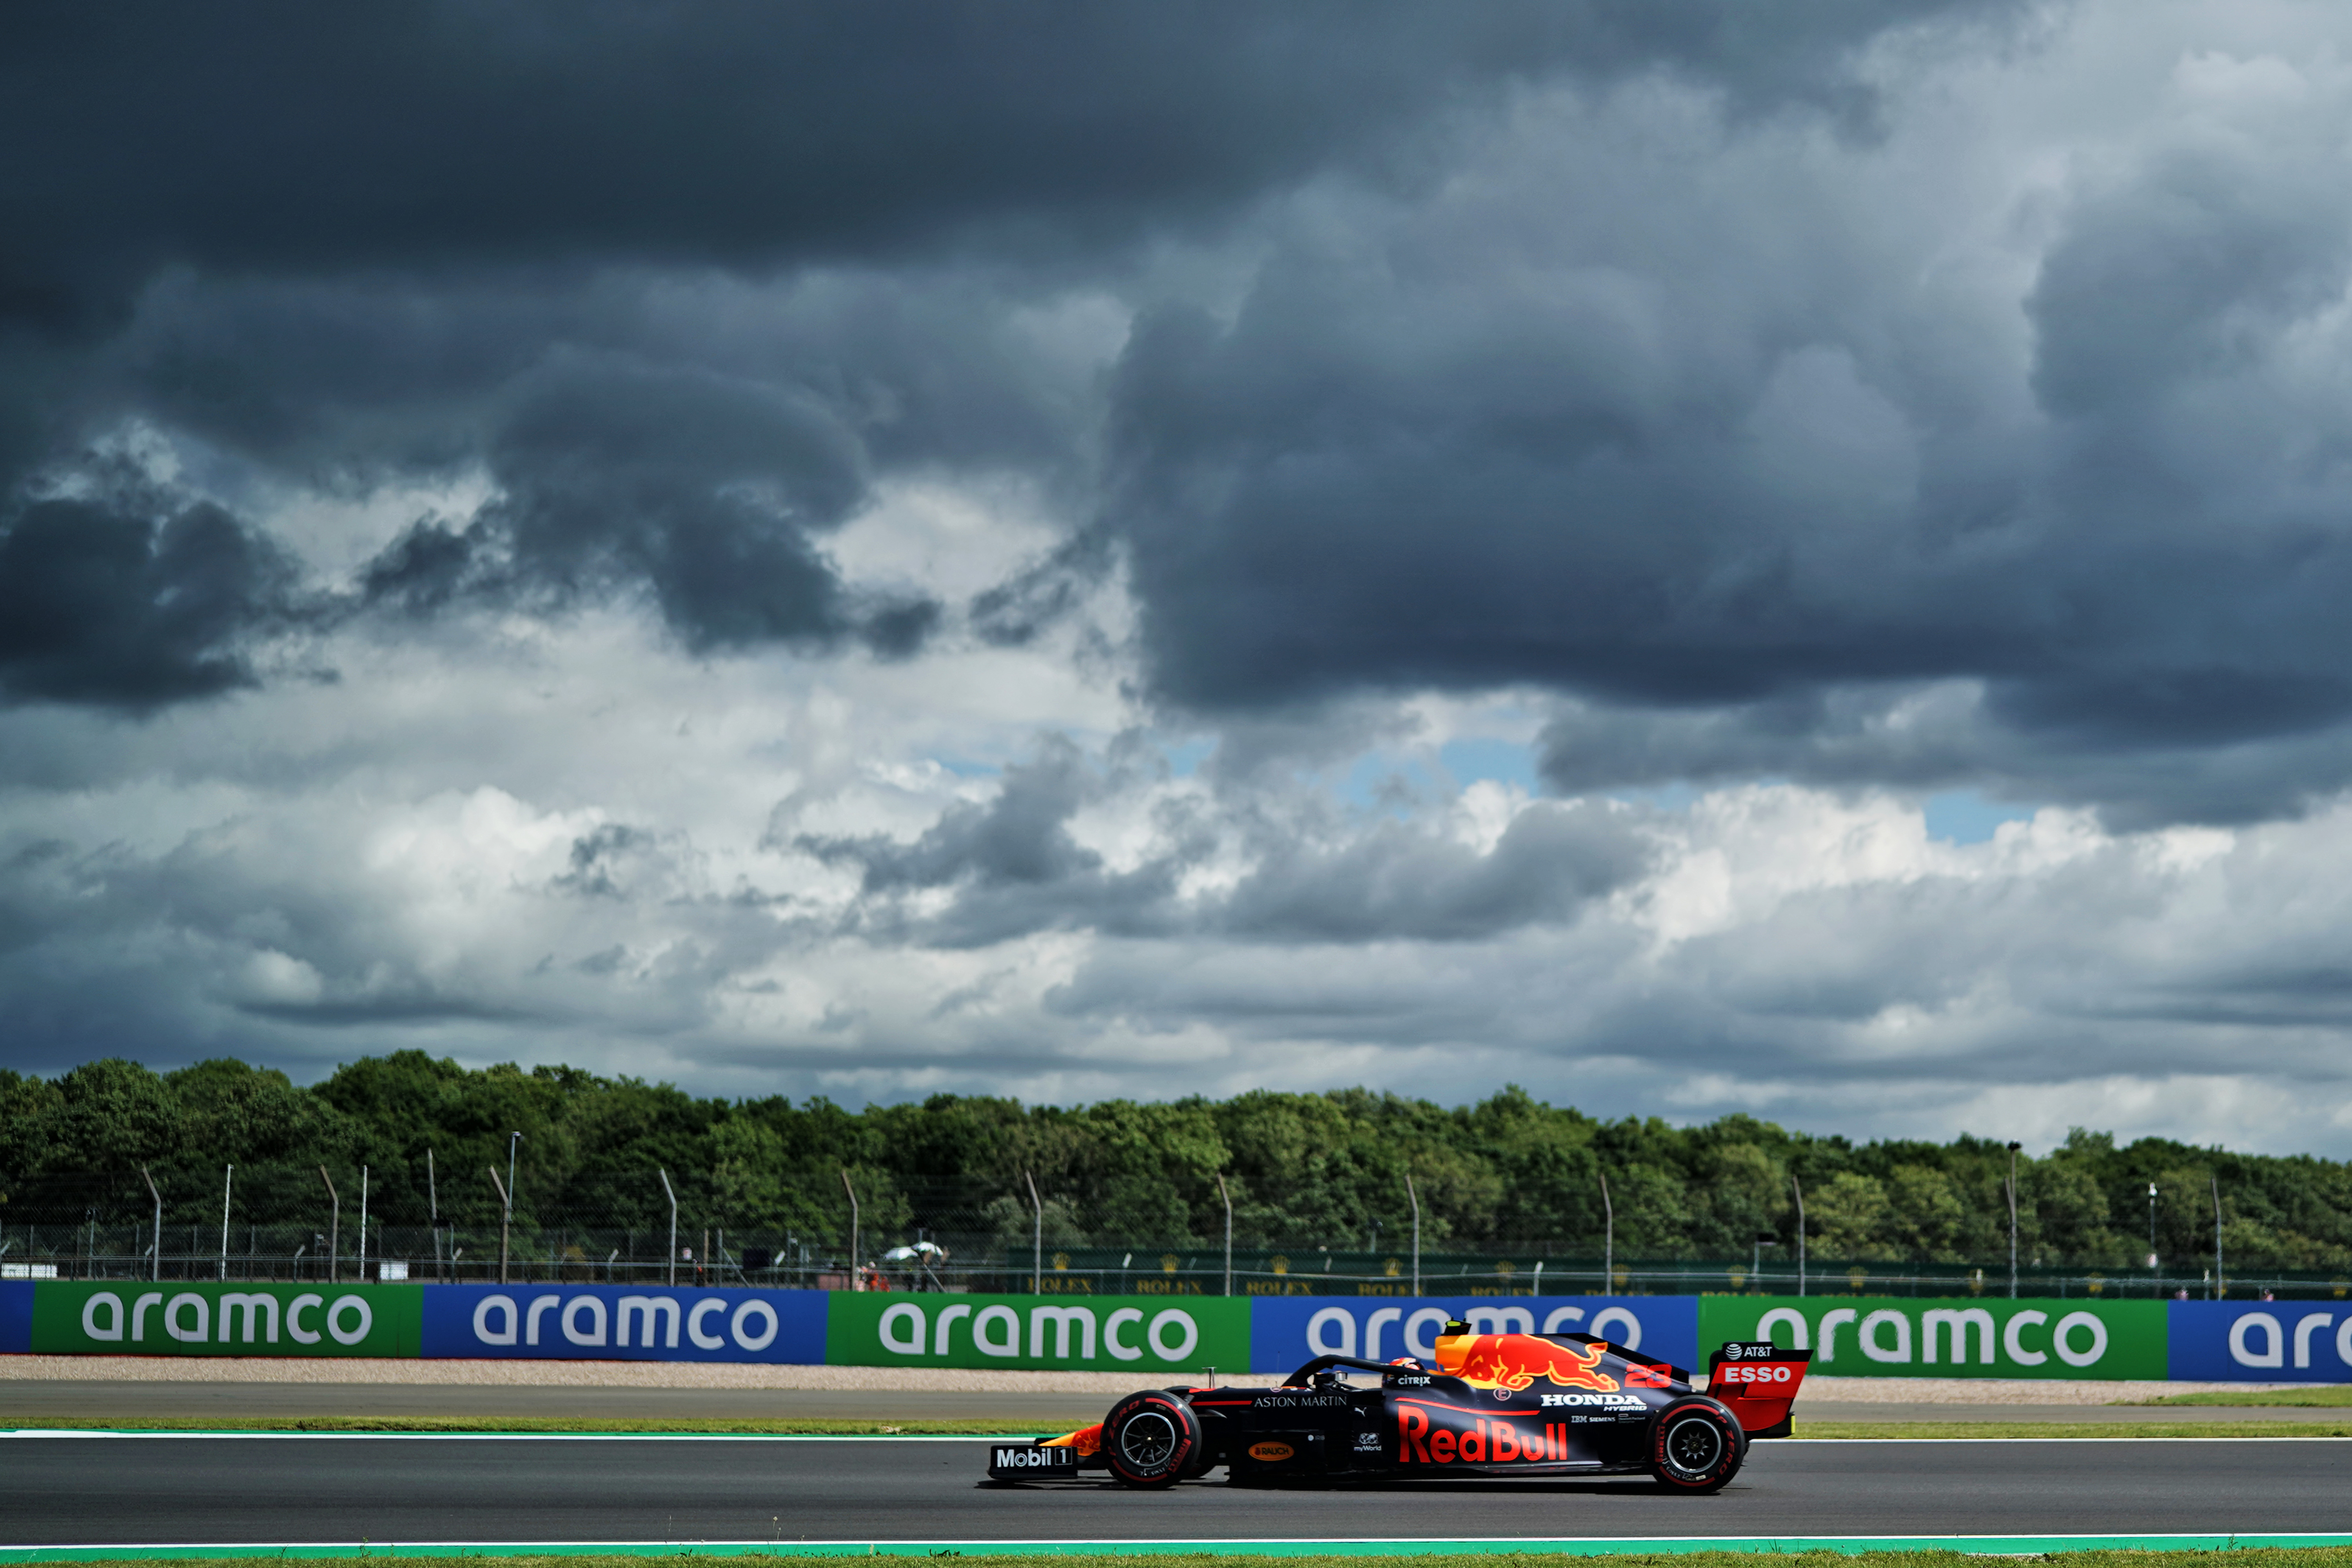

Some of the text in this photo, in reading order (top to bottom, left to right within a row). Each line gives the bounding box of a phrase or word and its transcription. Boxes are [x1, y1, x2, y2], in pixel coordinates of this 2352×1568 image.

[82, 1291, 372, 1345] aramco
[473, 1294, 779, 1351] aramco
[878, 1302, 1198, 1361] aramco
[1756, 1307, 2108, 1367] aramco
[2229, 1312, 2352, 1368] ar
[1744, 1346, 1772, 1357] AT&T
[1624, 1364, 1672, 1388] 23
[1725, 1367, 1791, 1382] ESSO
[1254, 1396, 1347, 1407] ASTON MARTIN
[1541, 1394, 1646, 1406] HONDA
[1398, 1405, 1567, 1463] Red Bull
[1719, 1430, 1735, 1475] ZERO
[997, 1448, 1066, 1468] Mobil 1
